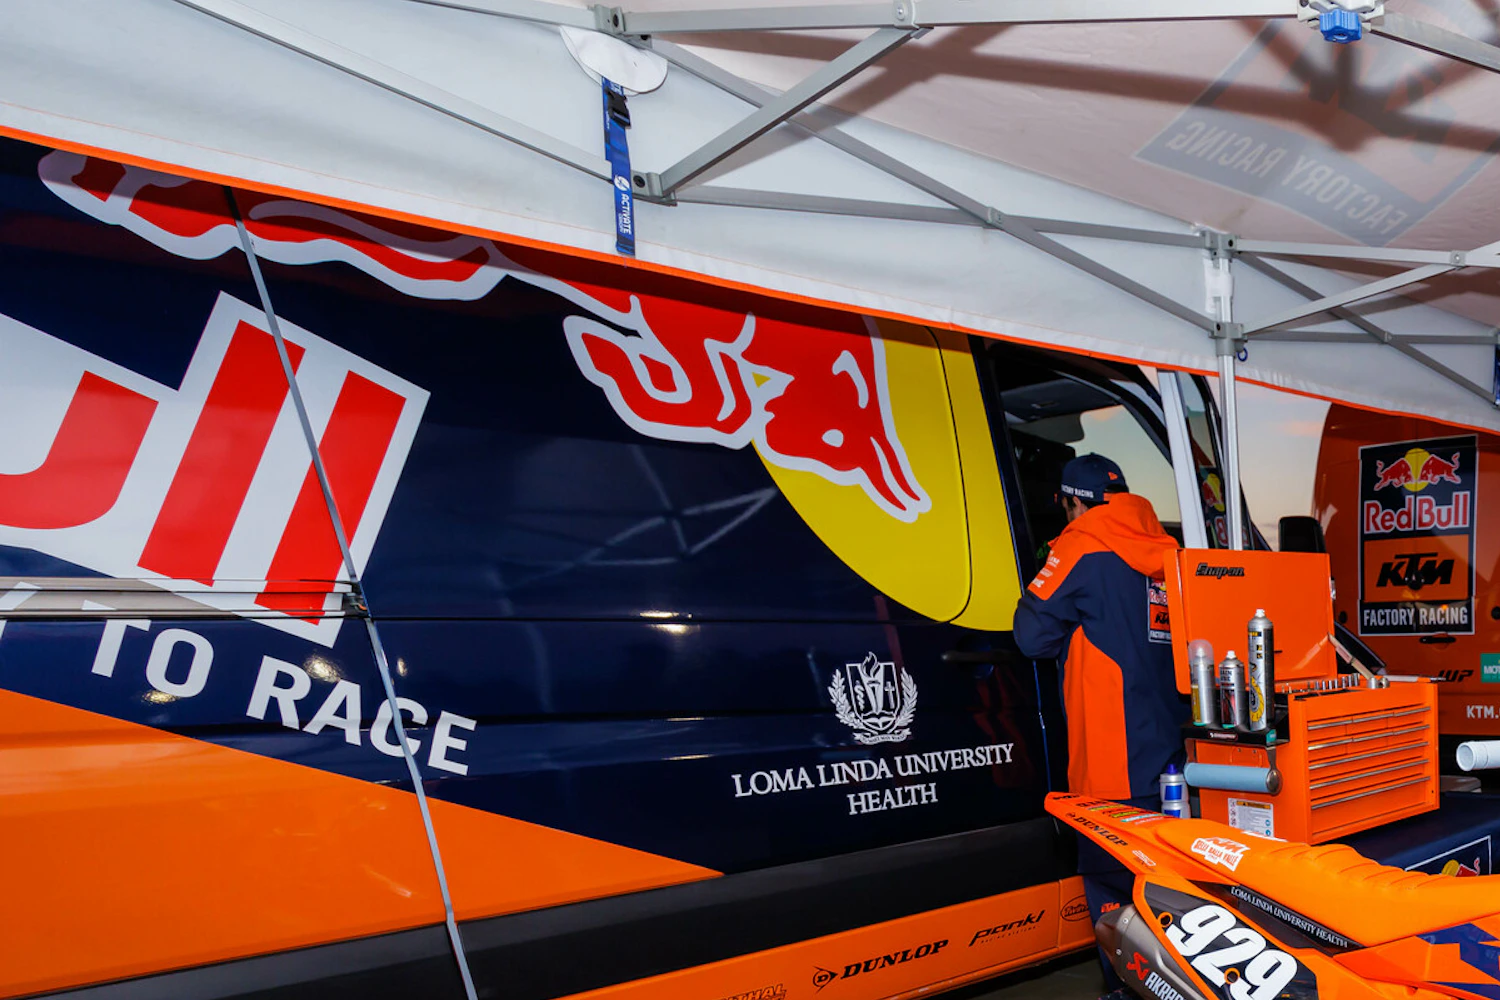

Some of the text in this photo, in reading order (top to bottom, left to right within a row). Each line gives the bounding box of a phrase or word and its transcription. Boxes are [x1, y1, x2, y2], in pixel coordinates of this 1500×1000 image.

[0, 318, 408, 626] ull
[1364, 490, 1471, 534] Red Bull
[1376, 552, 1455, 588] KTM
[1363, 605, 1469, 628] FACTORY RACING
[81, 600, 214, 698] TO
[245, 654, 480, 776] RACE
[732, 743, 1015, 798] LOMA LINDA UNIVERSITY
[847, 783, 939, 816] HEALTH
[1074, 816, 1129, 847] DUNLOP
[968, 910, 1046, 947] pankl
[1230, 886, 1348, 948] LOMA LINDA UNIVERSITY HEALTH
[840, 938, 949, 980] DUNLOP
